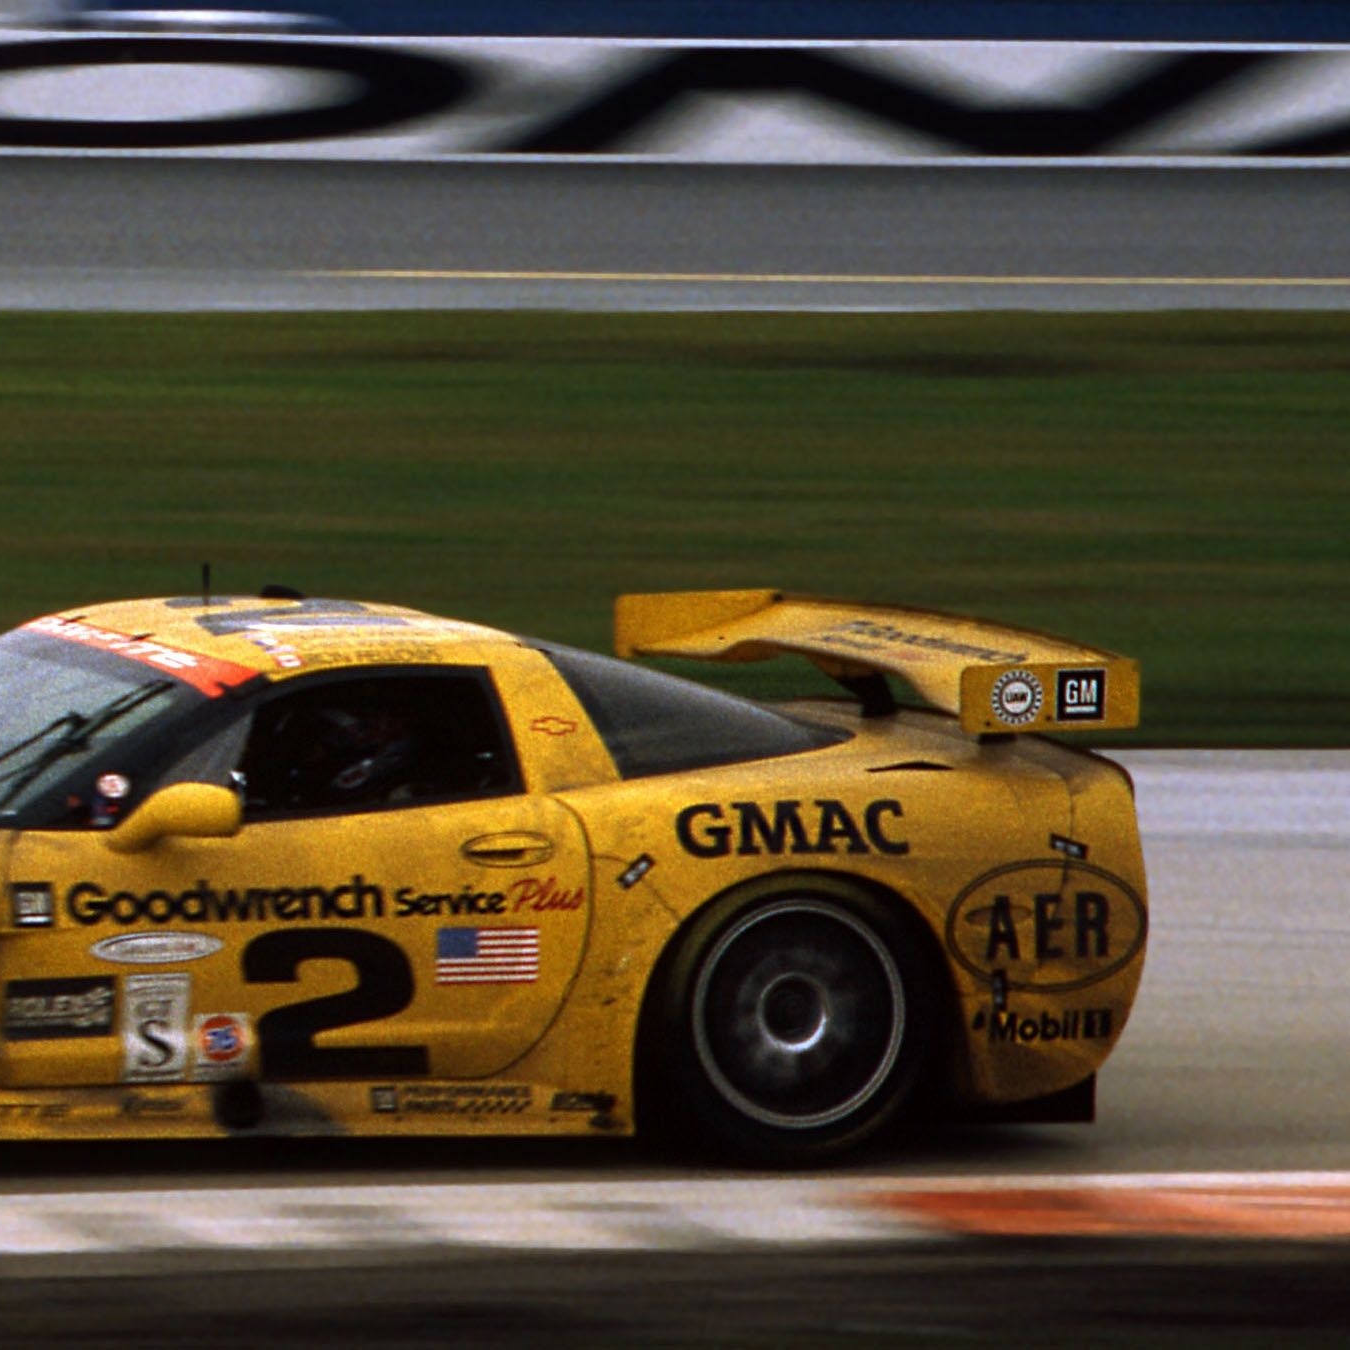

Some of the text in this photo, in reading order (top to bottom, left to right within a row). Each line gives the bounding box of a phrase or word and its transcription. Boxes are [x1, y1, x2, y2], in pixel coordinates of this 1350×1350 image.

[1065, 679, 1097, 704] GM
[675, 800, 910, 858] GMAC
[67, 875, 586, 925] Goodwrench Service Plus
[986, 891, 1110, 961] AER
[242, 926, 430, 1078] 2
[989, 1009, 1080, 1042] Mobil
